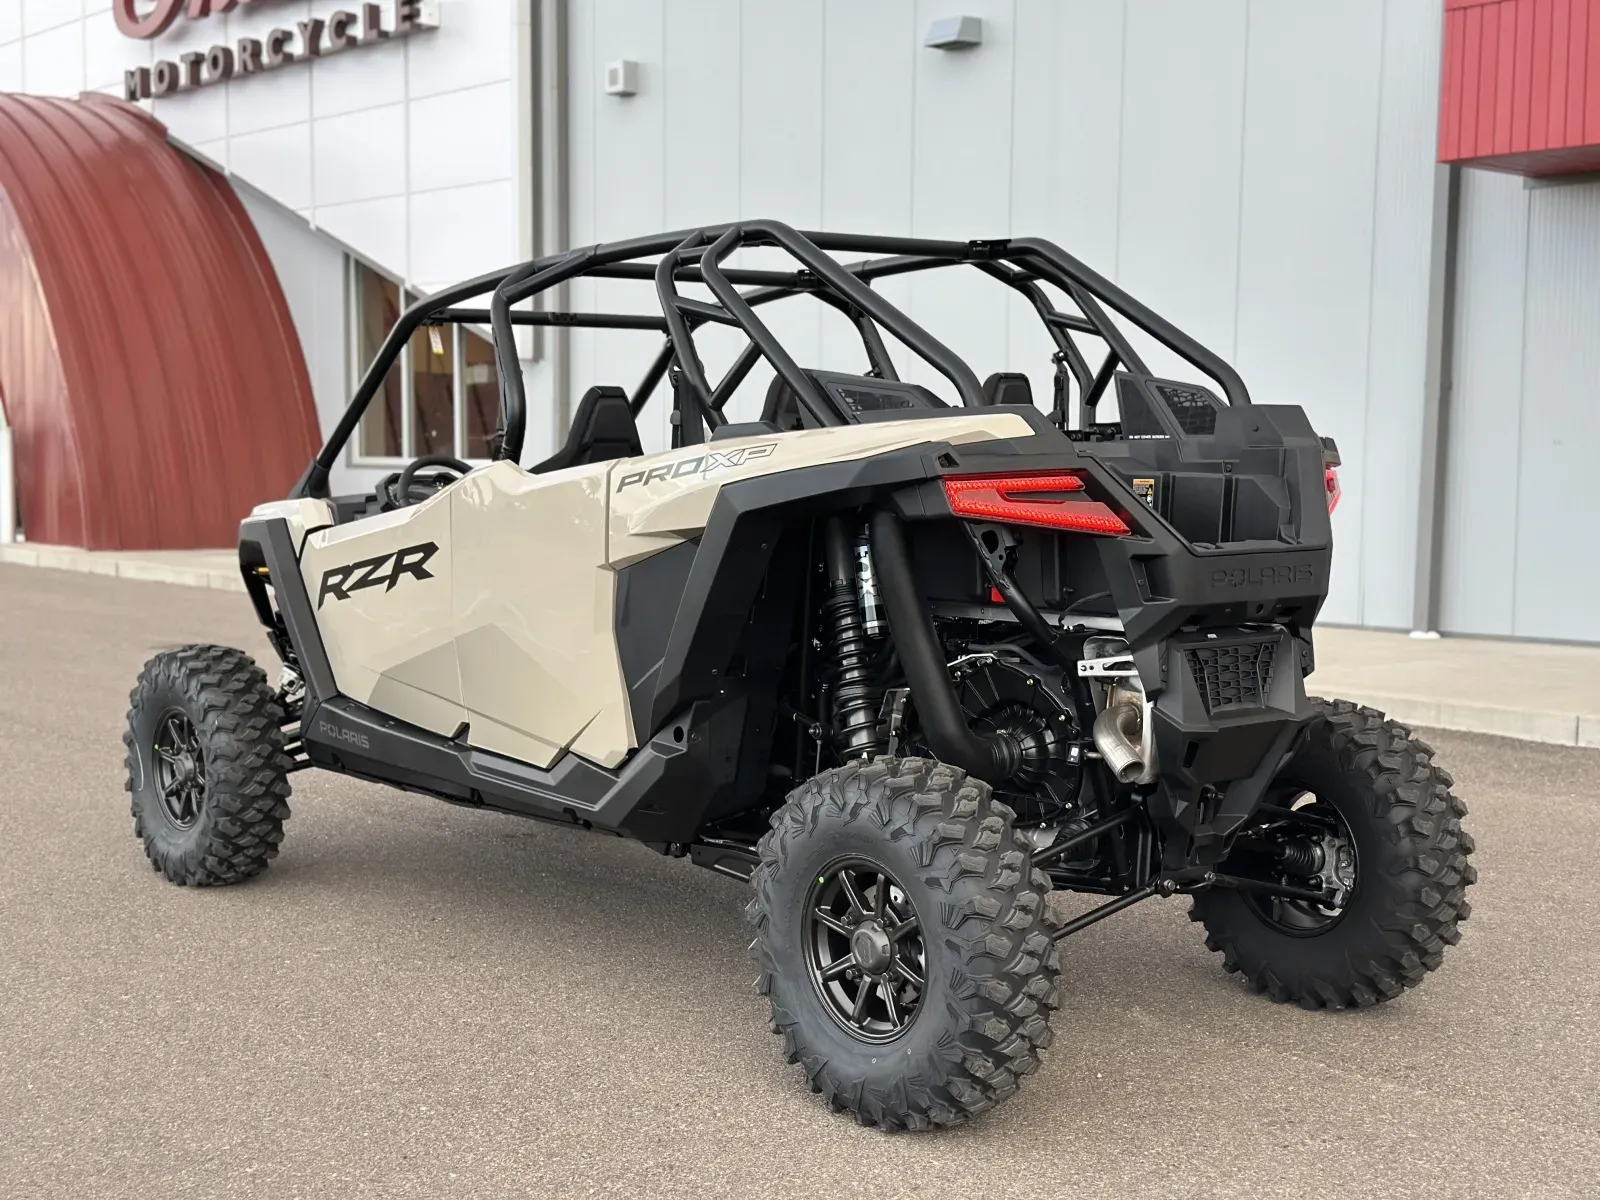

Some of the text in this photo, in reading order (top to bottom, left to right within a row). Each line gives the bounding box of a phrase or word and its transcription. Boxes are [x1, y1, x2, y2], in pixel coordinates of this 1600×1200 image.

[124, 0, 421, 101] MOTORCYCLE
[318, 541, 440, 611] RZR
[1211, 564, 1313, 588] POLARIS
[319, 720, 370, 749] POLARIS
